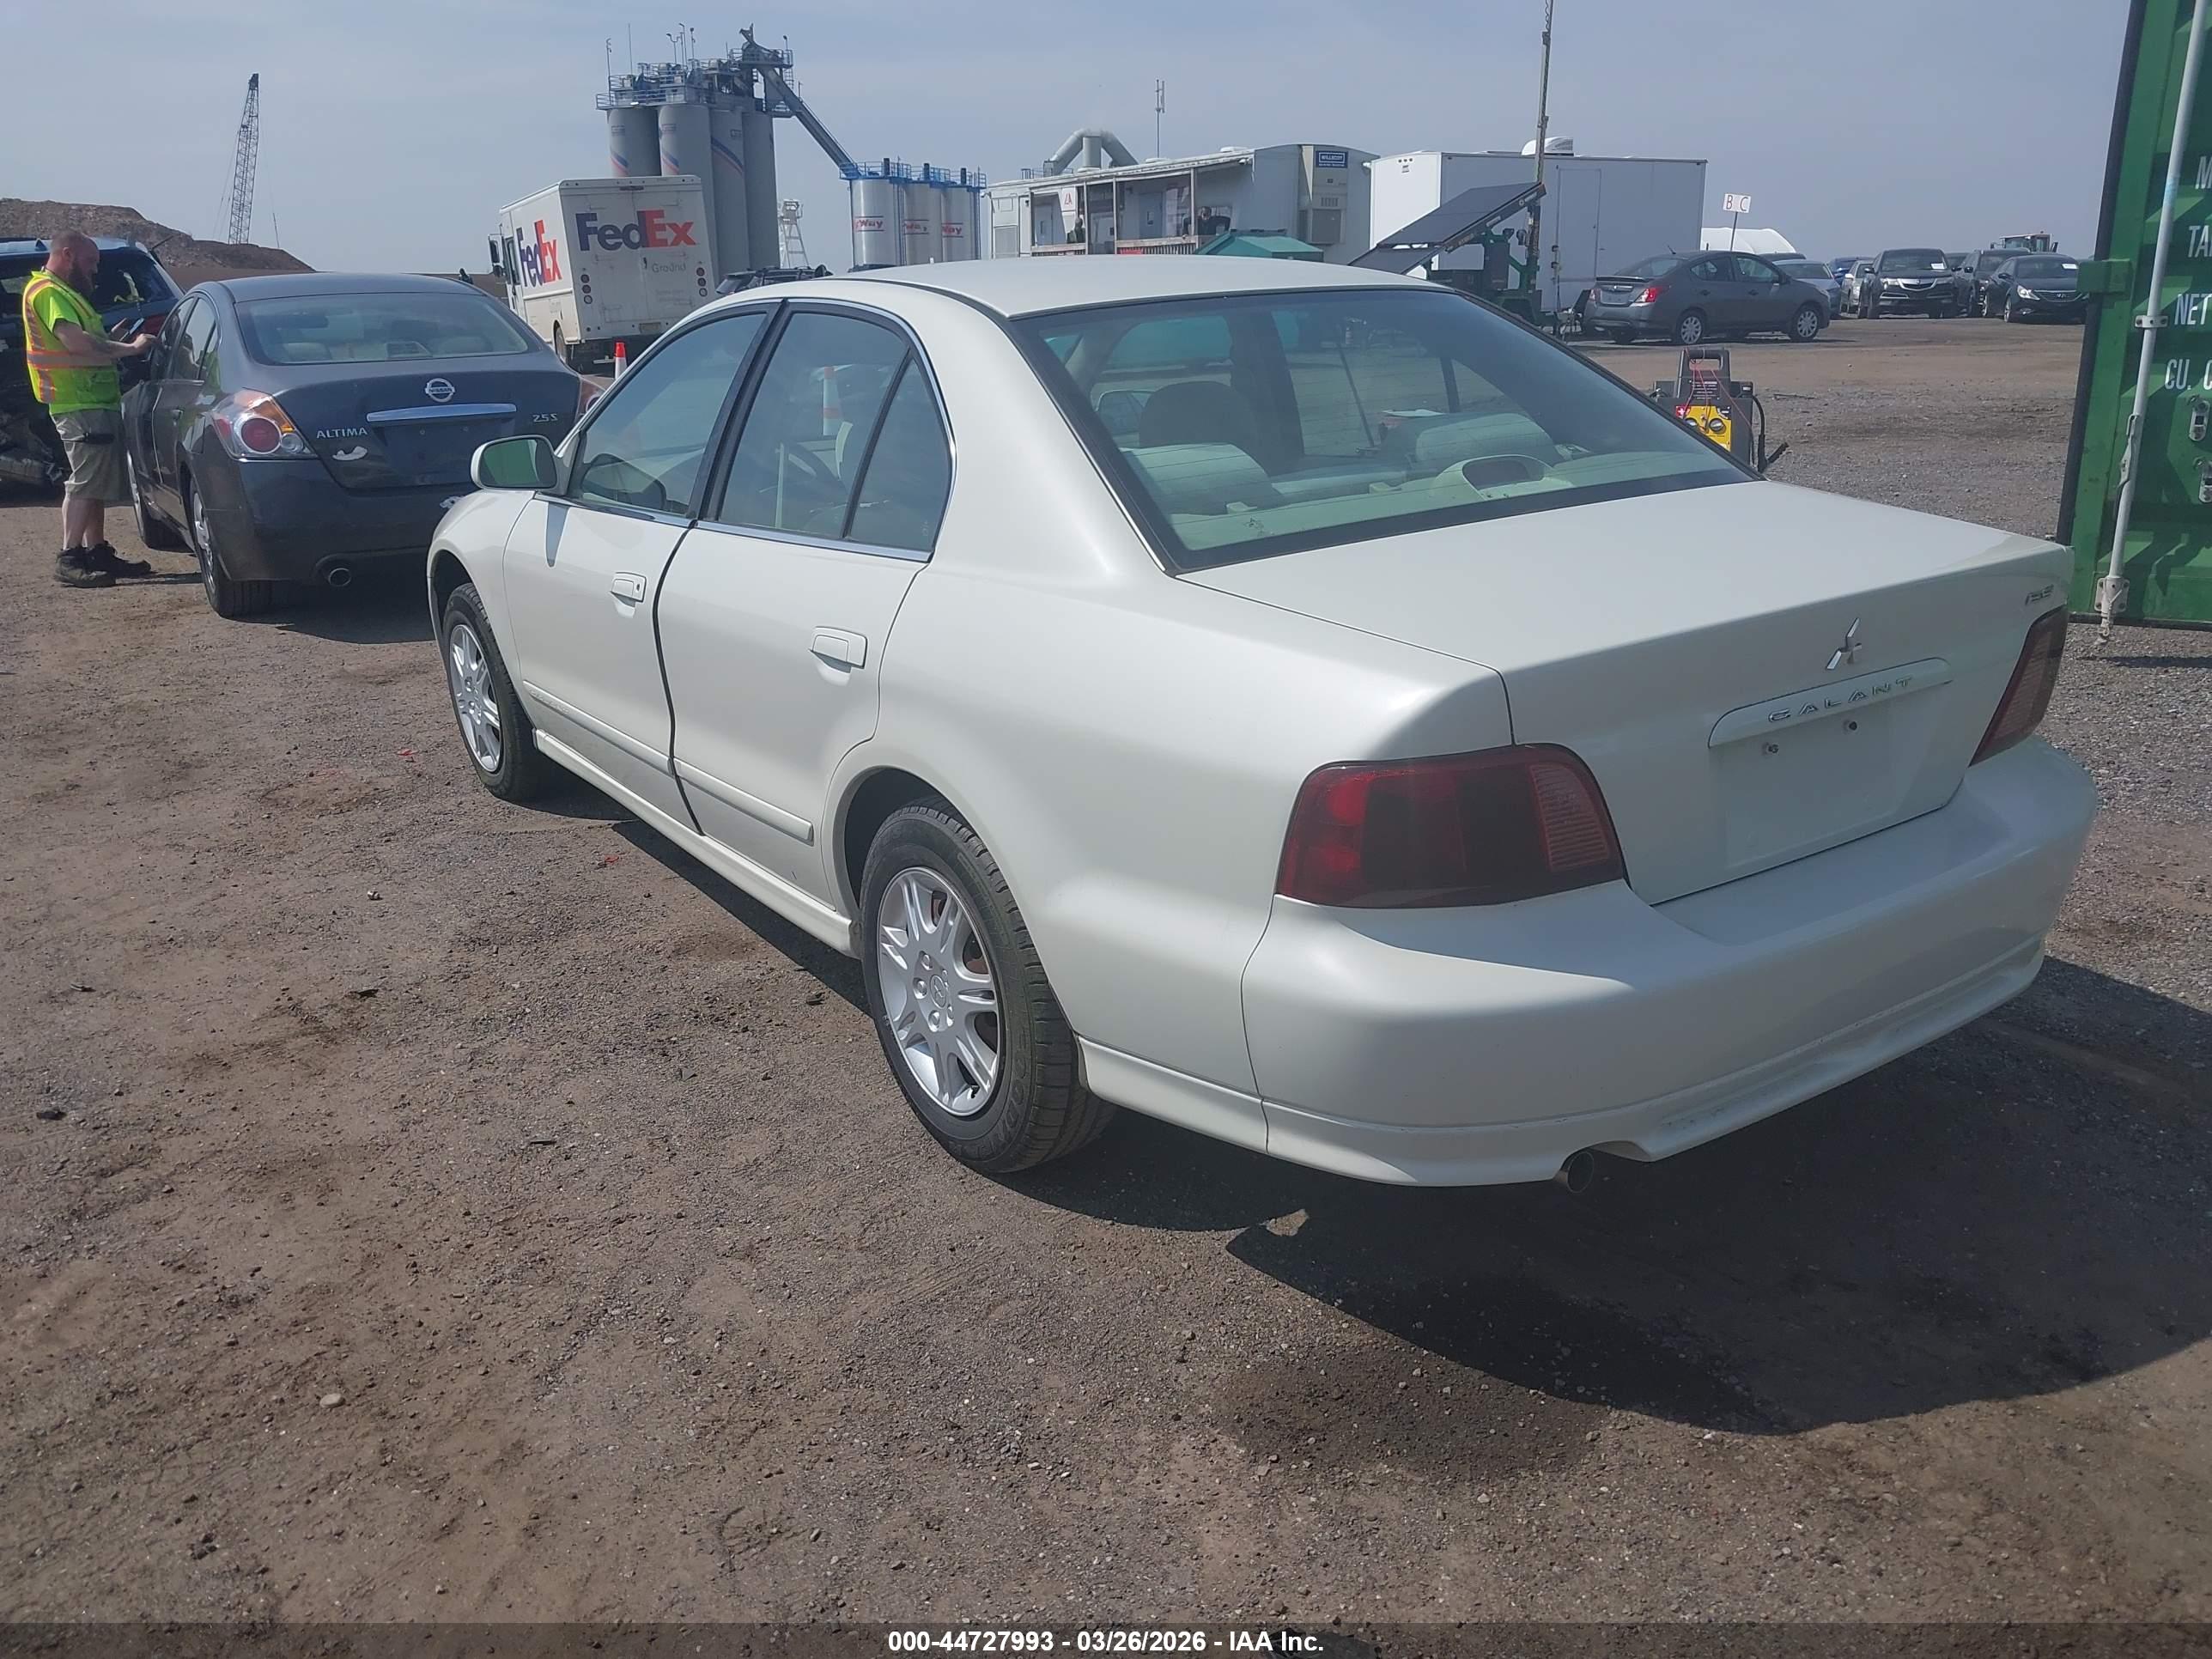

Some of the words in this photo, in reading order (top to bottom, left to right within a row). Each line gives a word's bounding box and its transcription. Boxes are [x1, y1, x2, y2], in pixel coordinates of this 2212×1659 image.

[1726, 195, 1733, 210] B
[1740, 197, 1748, 211] C
[575, 210, 696, 252] FedEx
[2187, 225, 2212, 258] TA
[516, 220, 562, 288] FedEx
[653, 262, 686, 273] Ground
[2174, 293, 2212, 325] NET
[2165, 359, 2191, 391] CU.
[316, 427, 368, 439] ALTIMA
[1768, 677, 1912, 723] GALANT
